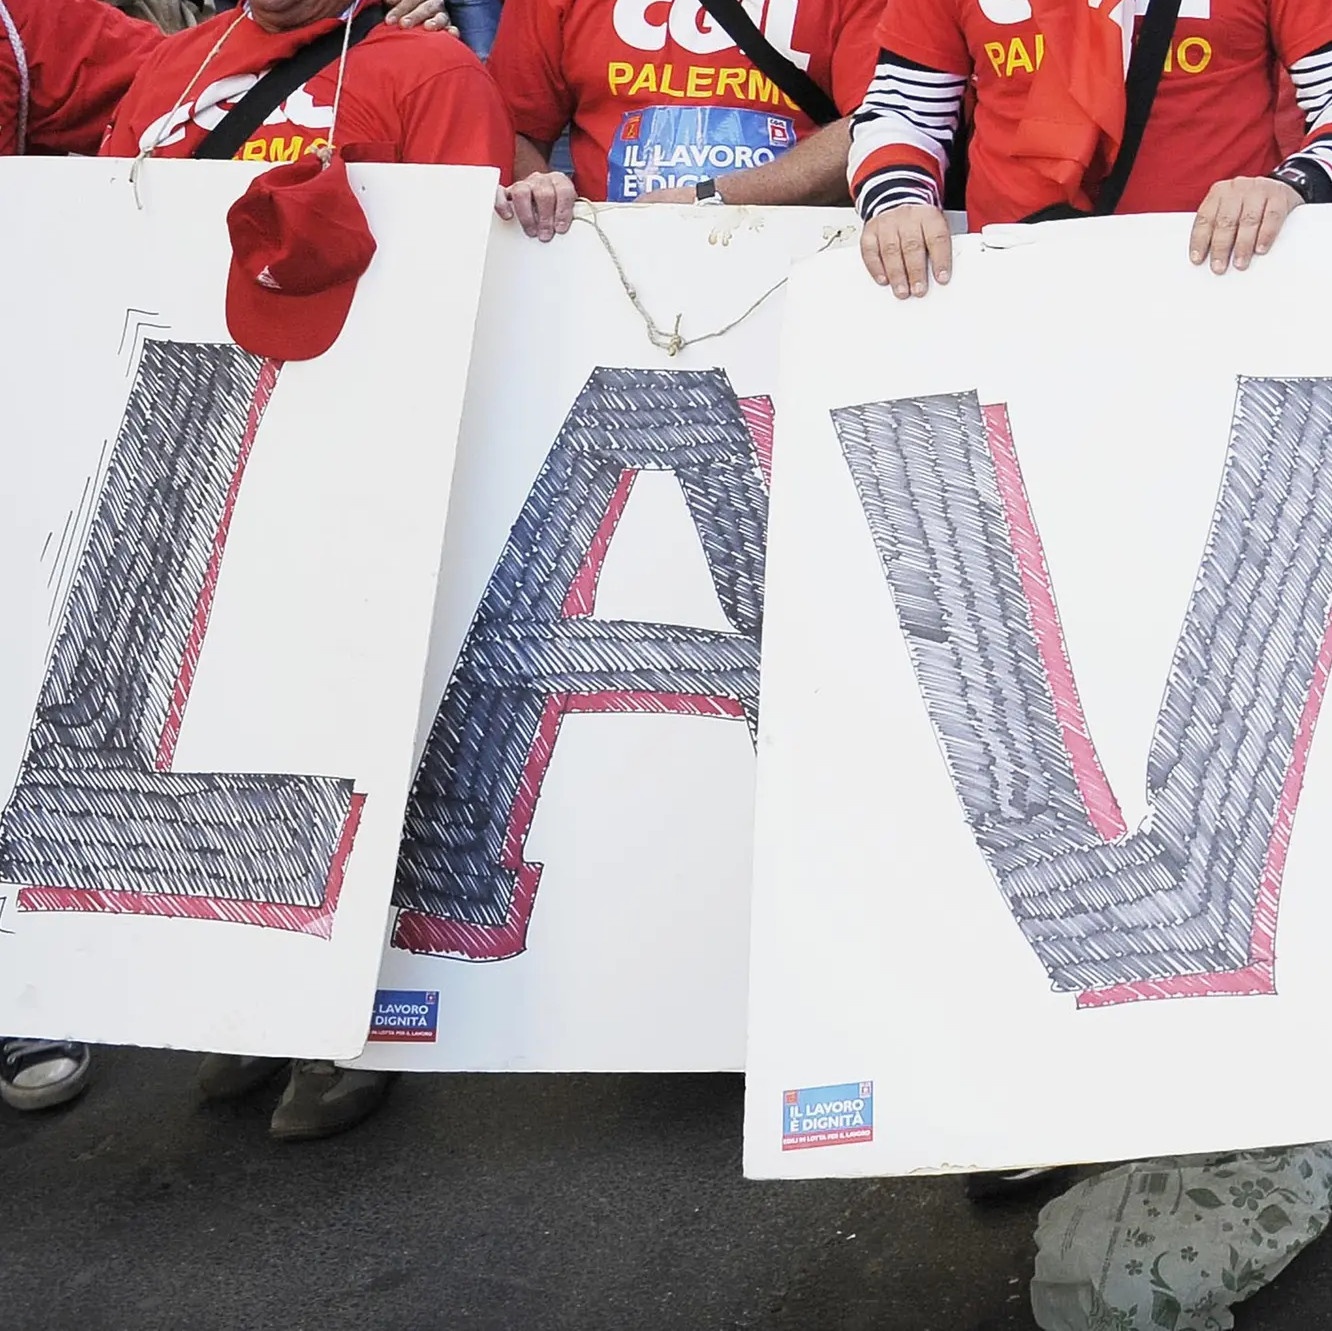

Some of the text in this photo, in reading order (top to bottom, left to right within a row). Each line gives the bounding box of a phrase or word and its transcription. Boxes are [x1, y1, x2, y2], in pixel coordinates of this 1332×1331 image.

[624, 144, 776, 168] IL LAVORO
[623, 169, 639, 198] È
[0, 338, 368, 941] L
[391, 366, 776, 963] A
[379, 1004, 429, 1014] LAVORO
[375, 1015, 428, 1026] DIGNITÀ
[789, 1099, 864, 1118] IL LAVORO
[790, 1111, 864, 1132] È DIGNITÀ
